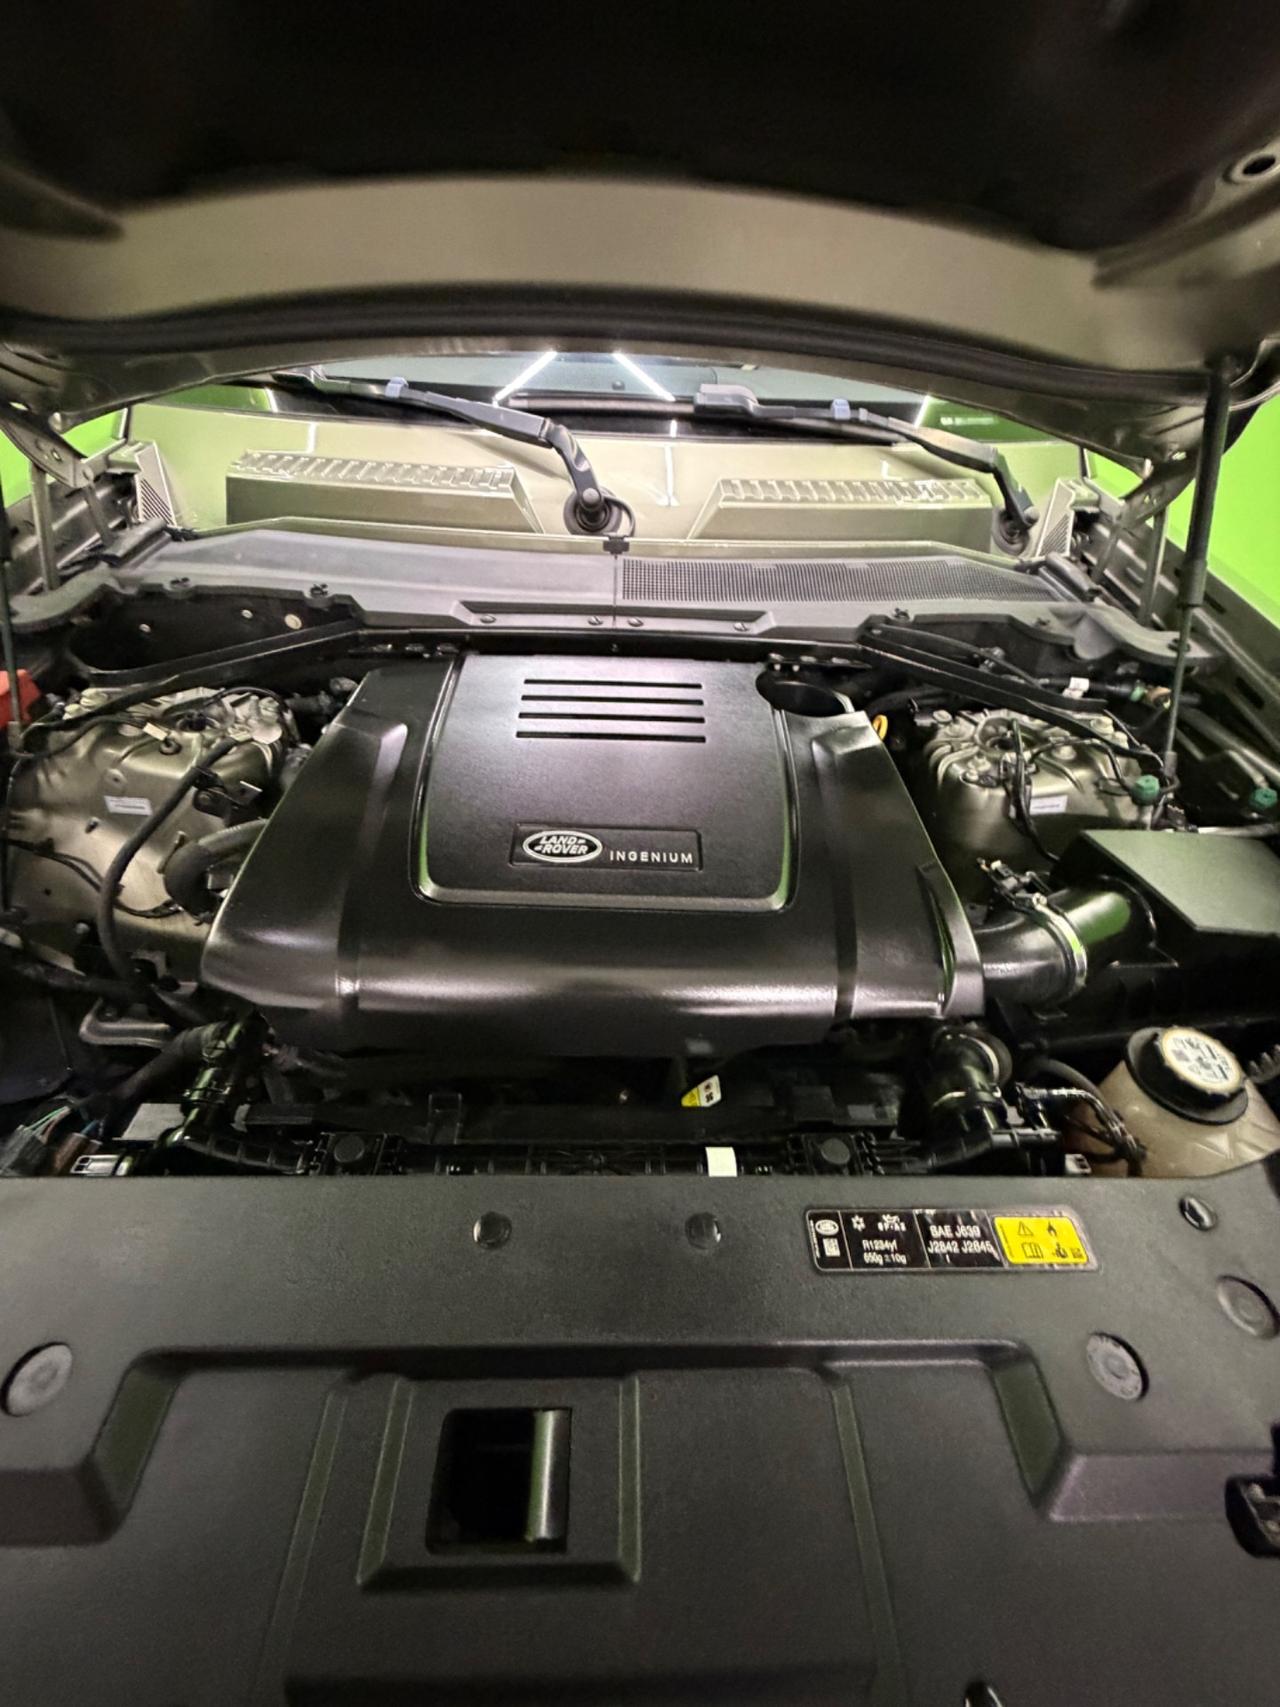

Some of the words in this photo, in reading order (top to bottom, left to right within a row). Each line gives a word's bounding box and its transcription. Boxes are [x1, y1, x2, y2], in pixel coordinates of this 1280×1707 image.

[540, 836, 579, 845] LAND
[542, 845, 588, 855] ROVER
[609, 850, 693, 864] INGENIUM
[927, 1240, 960, 1254] J2842
[961, 1240, 993, 1254] J2845
